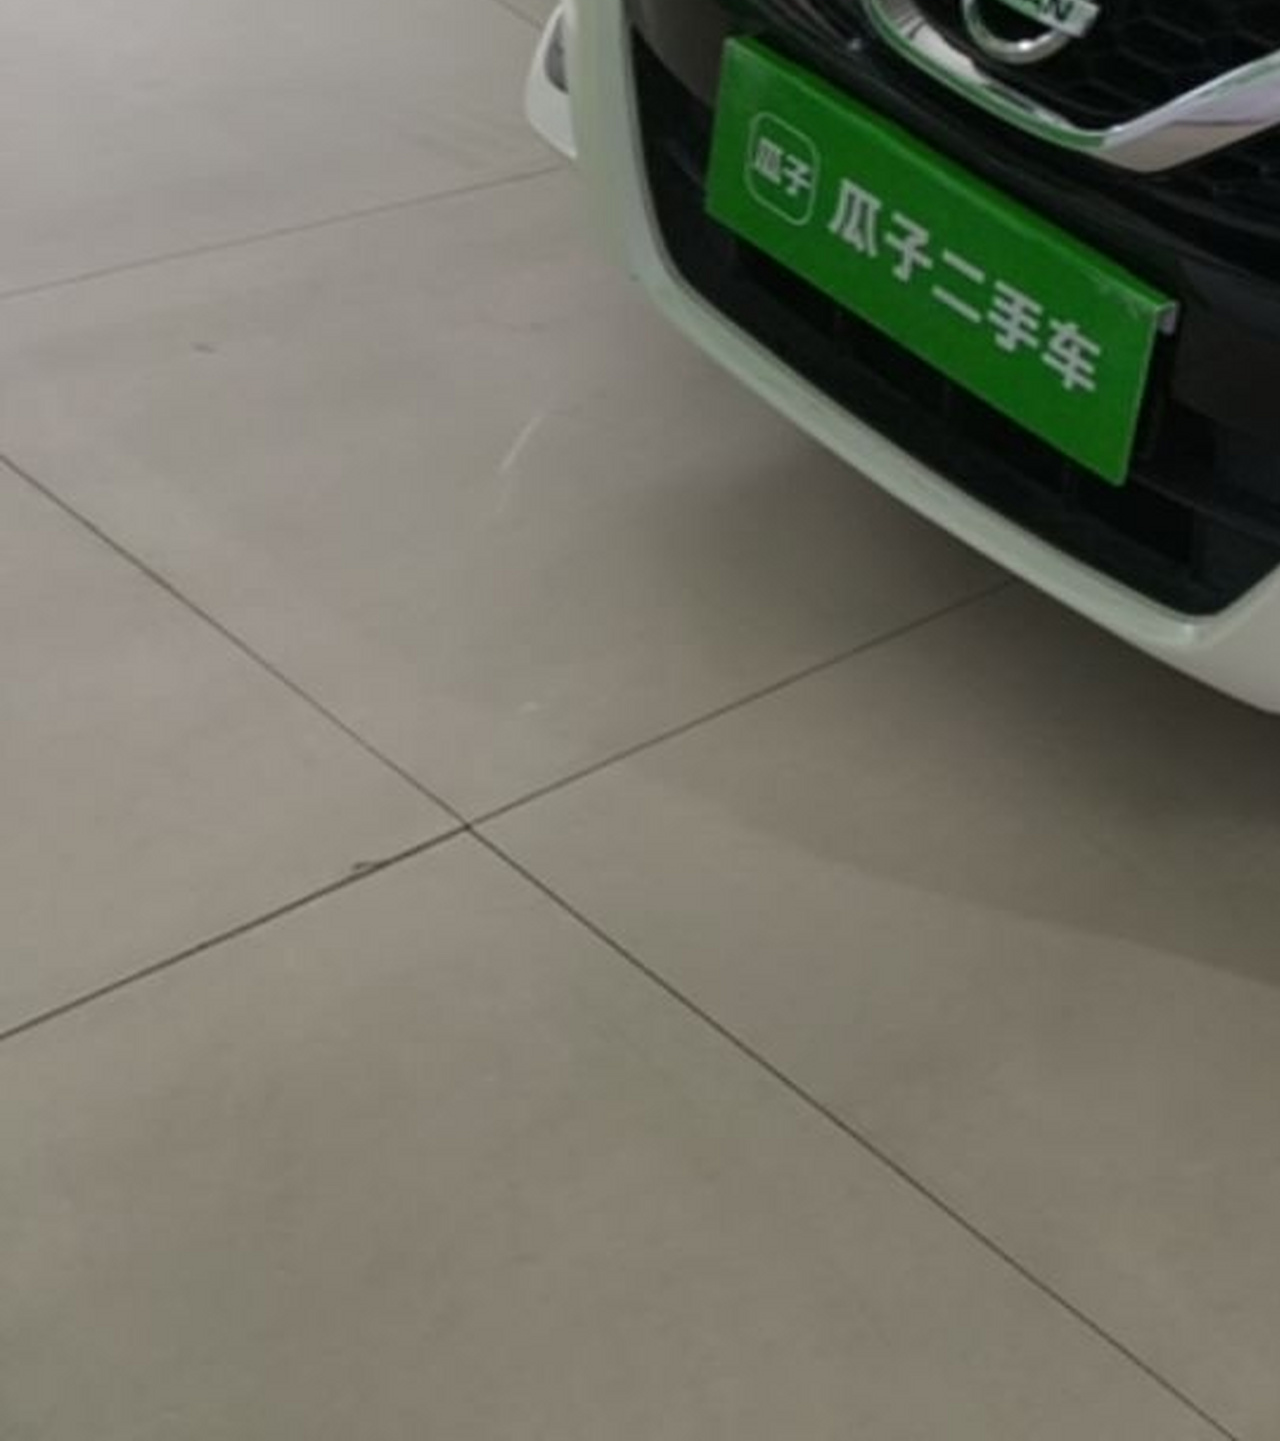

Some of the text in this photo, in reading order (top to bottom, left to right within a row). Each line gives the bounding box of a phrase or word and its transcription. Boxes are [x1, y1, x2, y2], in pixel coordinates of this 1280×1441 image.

[754, 137, 812, 197] 瓜子
[827, 177, 1101, 394] 瓜子二手车
